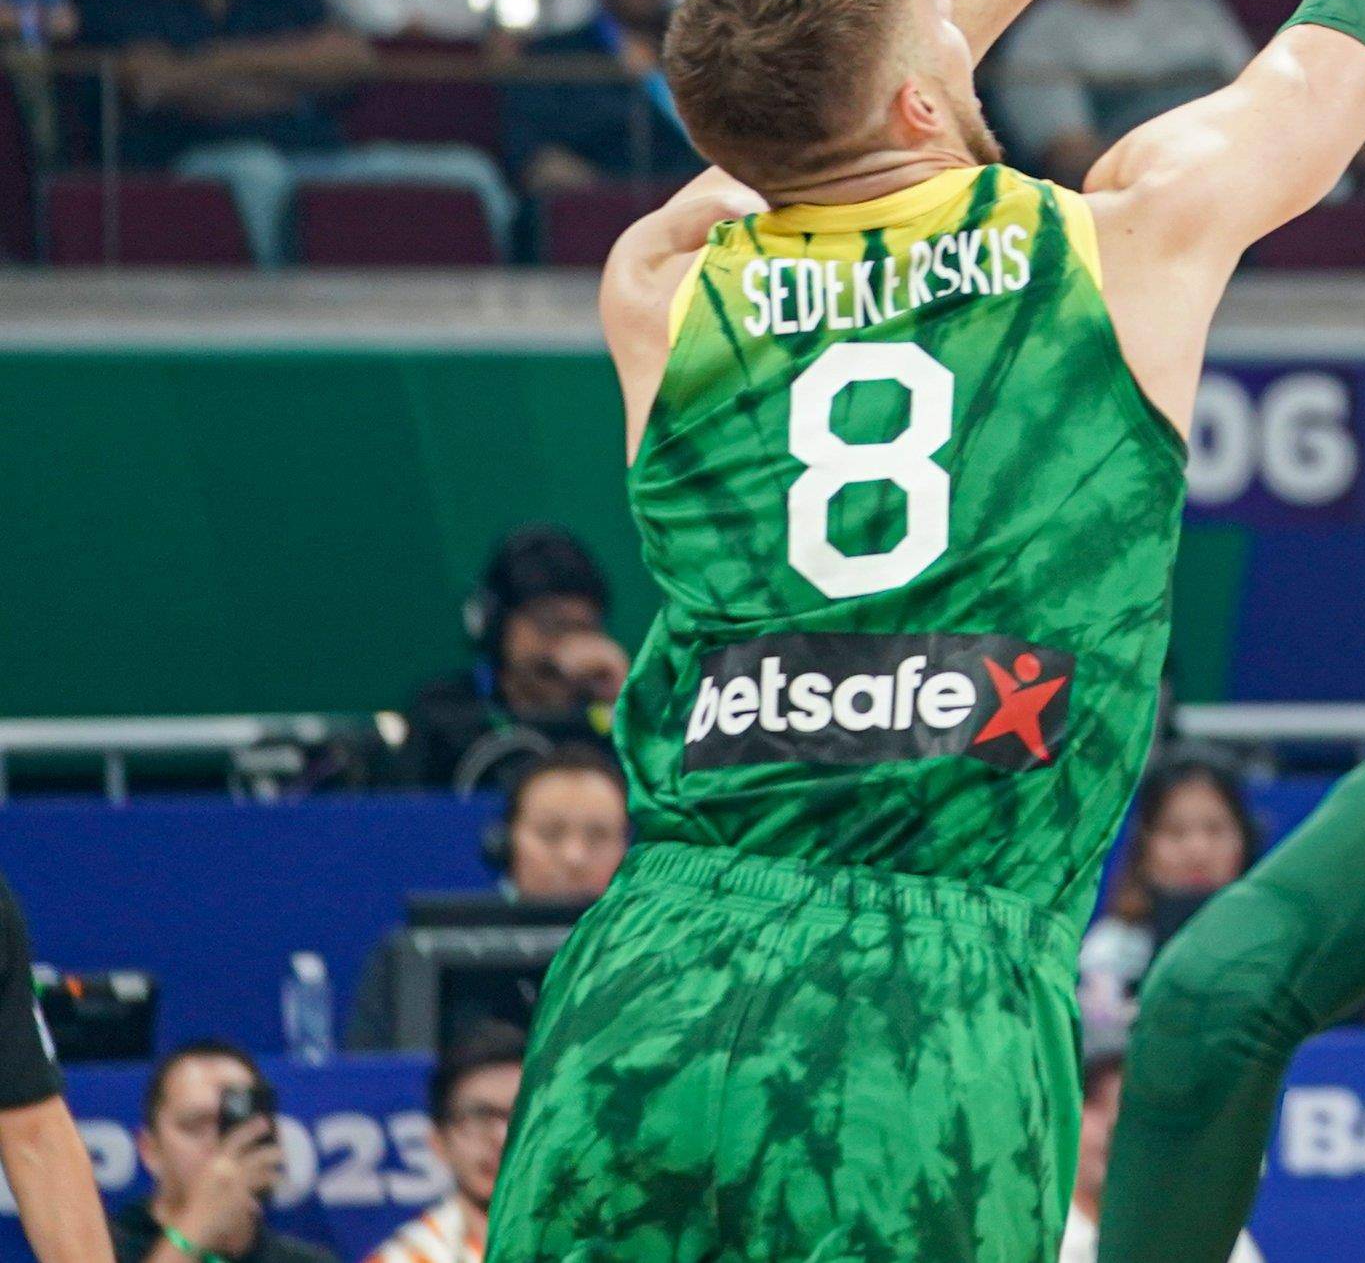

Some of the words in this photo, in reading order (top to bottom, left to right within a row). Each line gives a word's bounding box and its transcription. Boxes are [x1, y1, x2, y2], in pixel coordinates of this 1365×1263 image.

[742, 223, 1032, 338] SEDEKERSKIS
[786, 340, 955, 600] 8
[684, 655, 977, 744] betsafe
